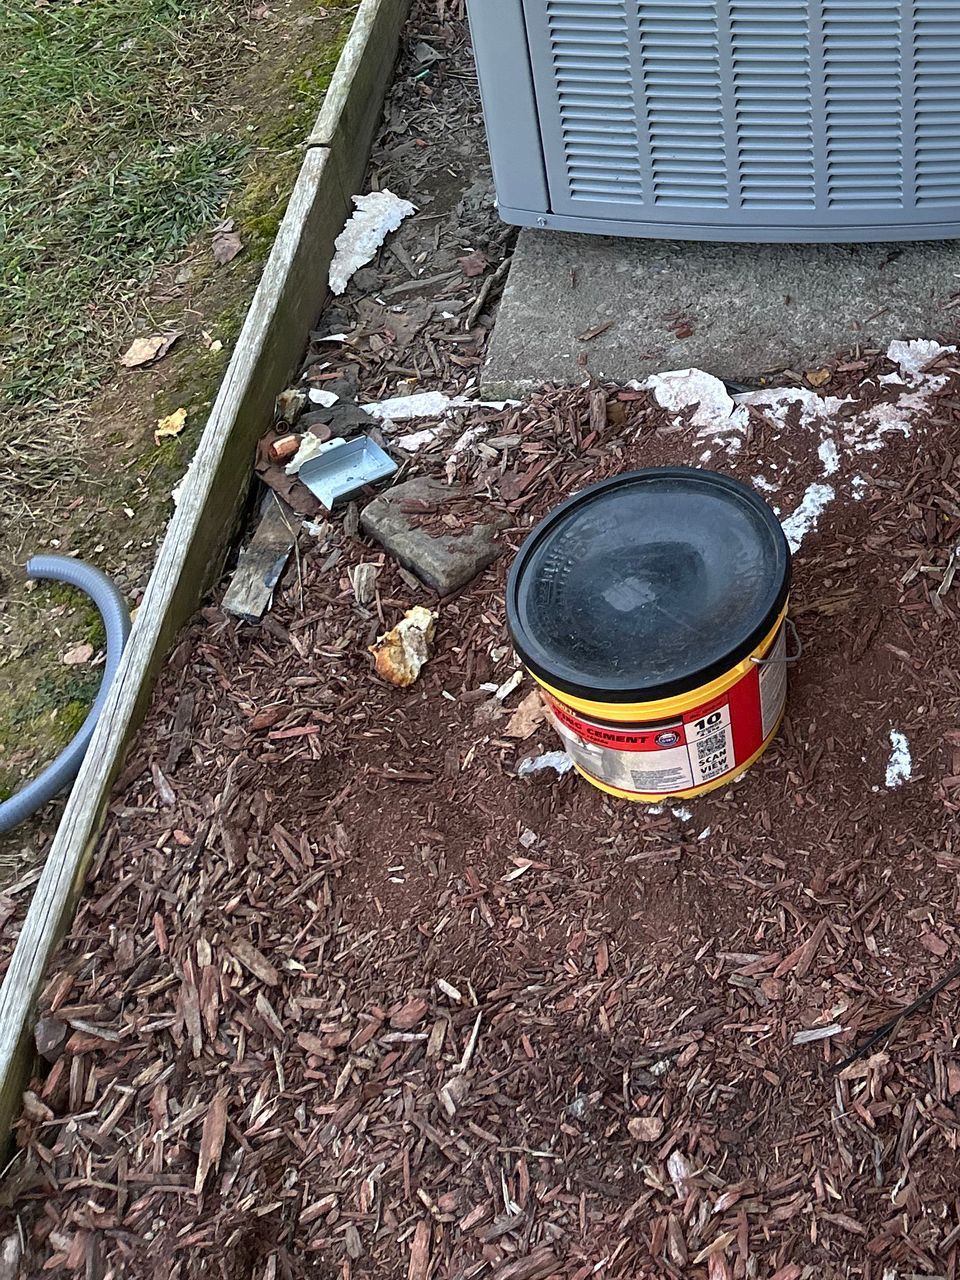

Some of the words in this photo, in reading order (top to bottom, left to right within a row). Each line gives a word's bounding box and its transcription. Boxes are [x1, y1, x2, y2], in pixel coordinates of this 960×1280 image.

[694, 712, 722, 730] 10
[586, 728, 649, 744] CEMENT
[698, 748, 727, 767] SCAN
[700, 756, 727, 774] VIEW
